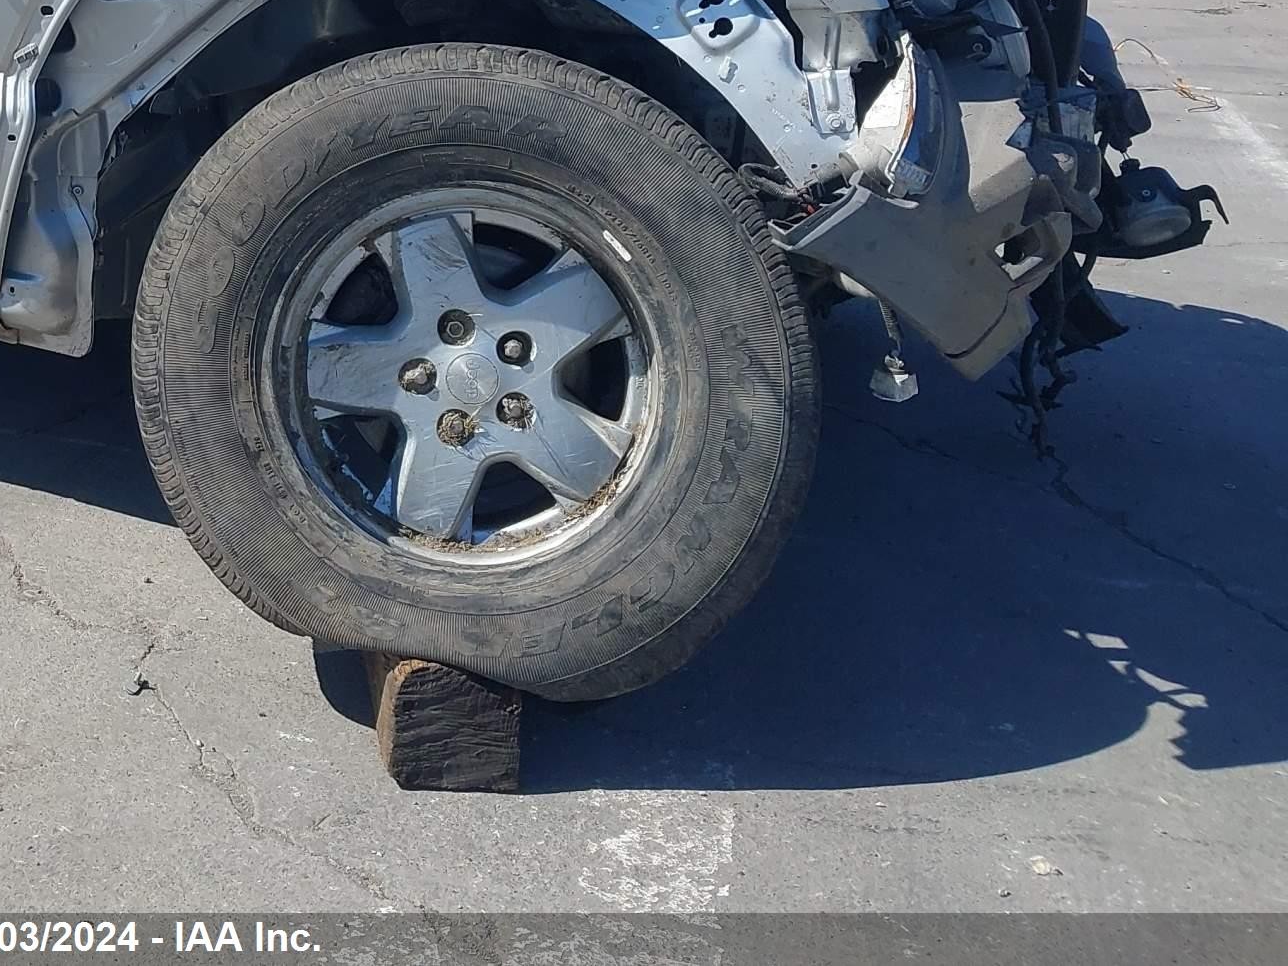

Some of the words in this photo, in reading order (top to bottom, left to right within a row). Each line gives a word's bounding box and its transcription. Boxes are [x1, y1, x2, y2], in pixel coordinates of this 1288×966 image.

[193, 103, 568, 356] GOODYEAR
[460, 318, 758, 662] WRANGLER
[465, 358, 481, 399] Jeep
